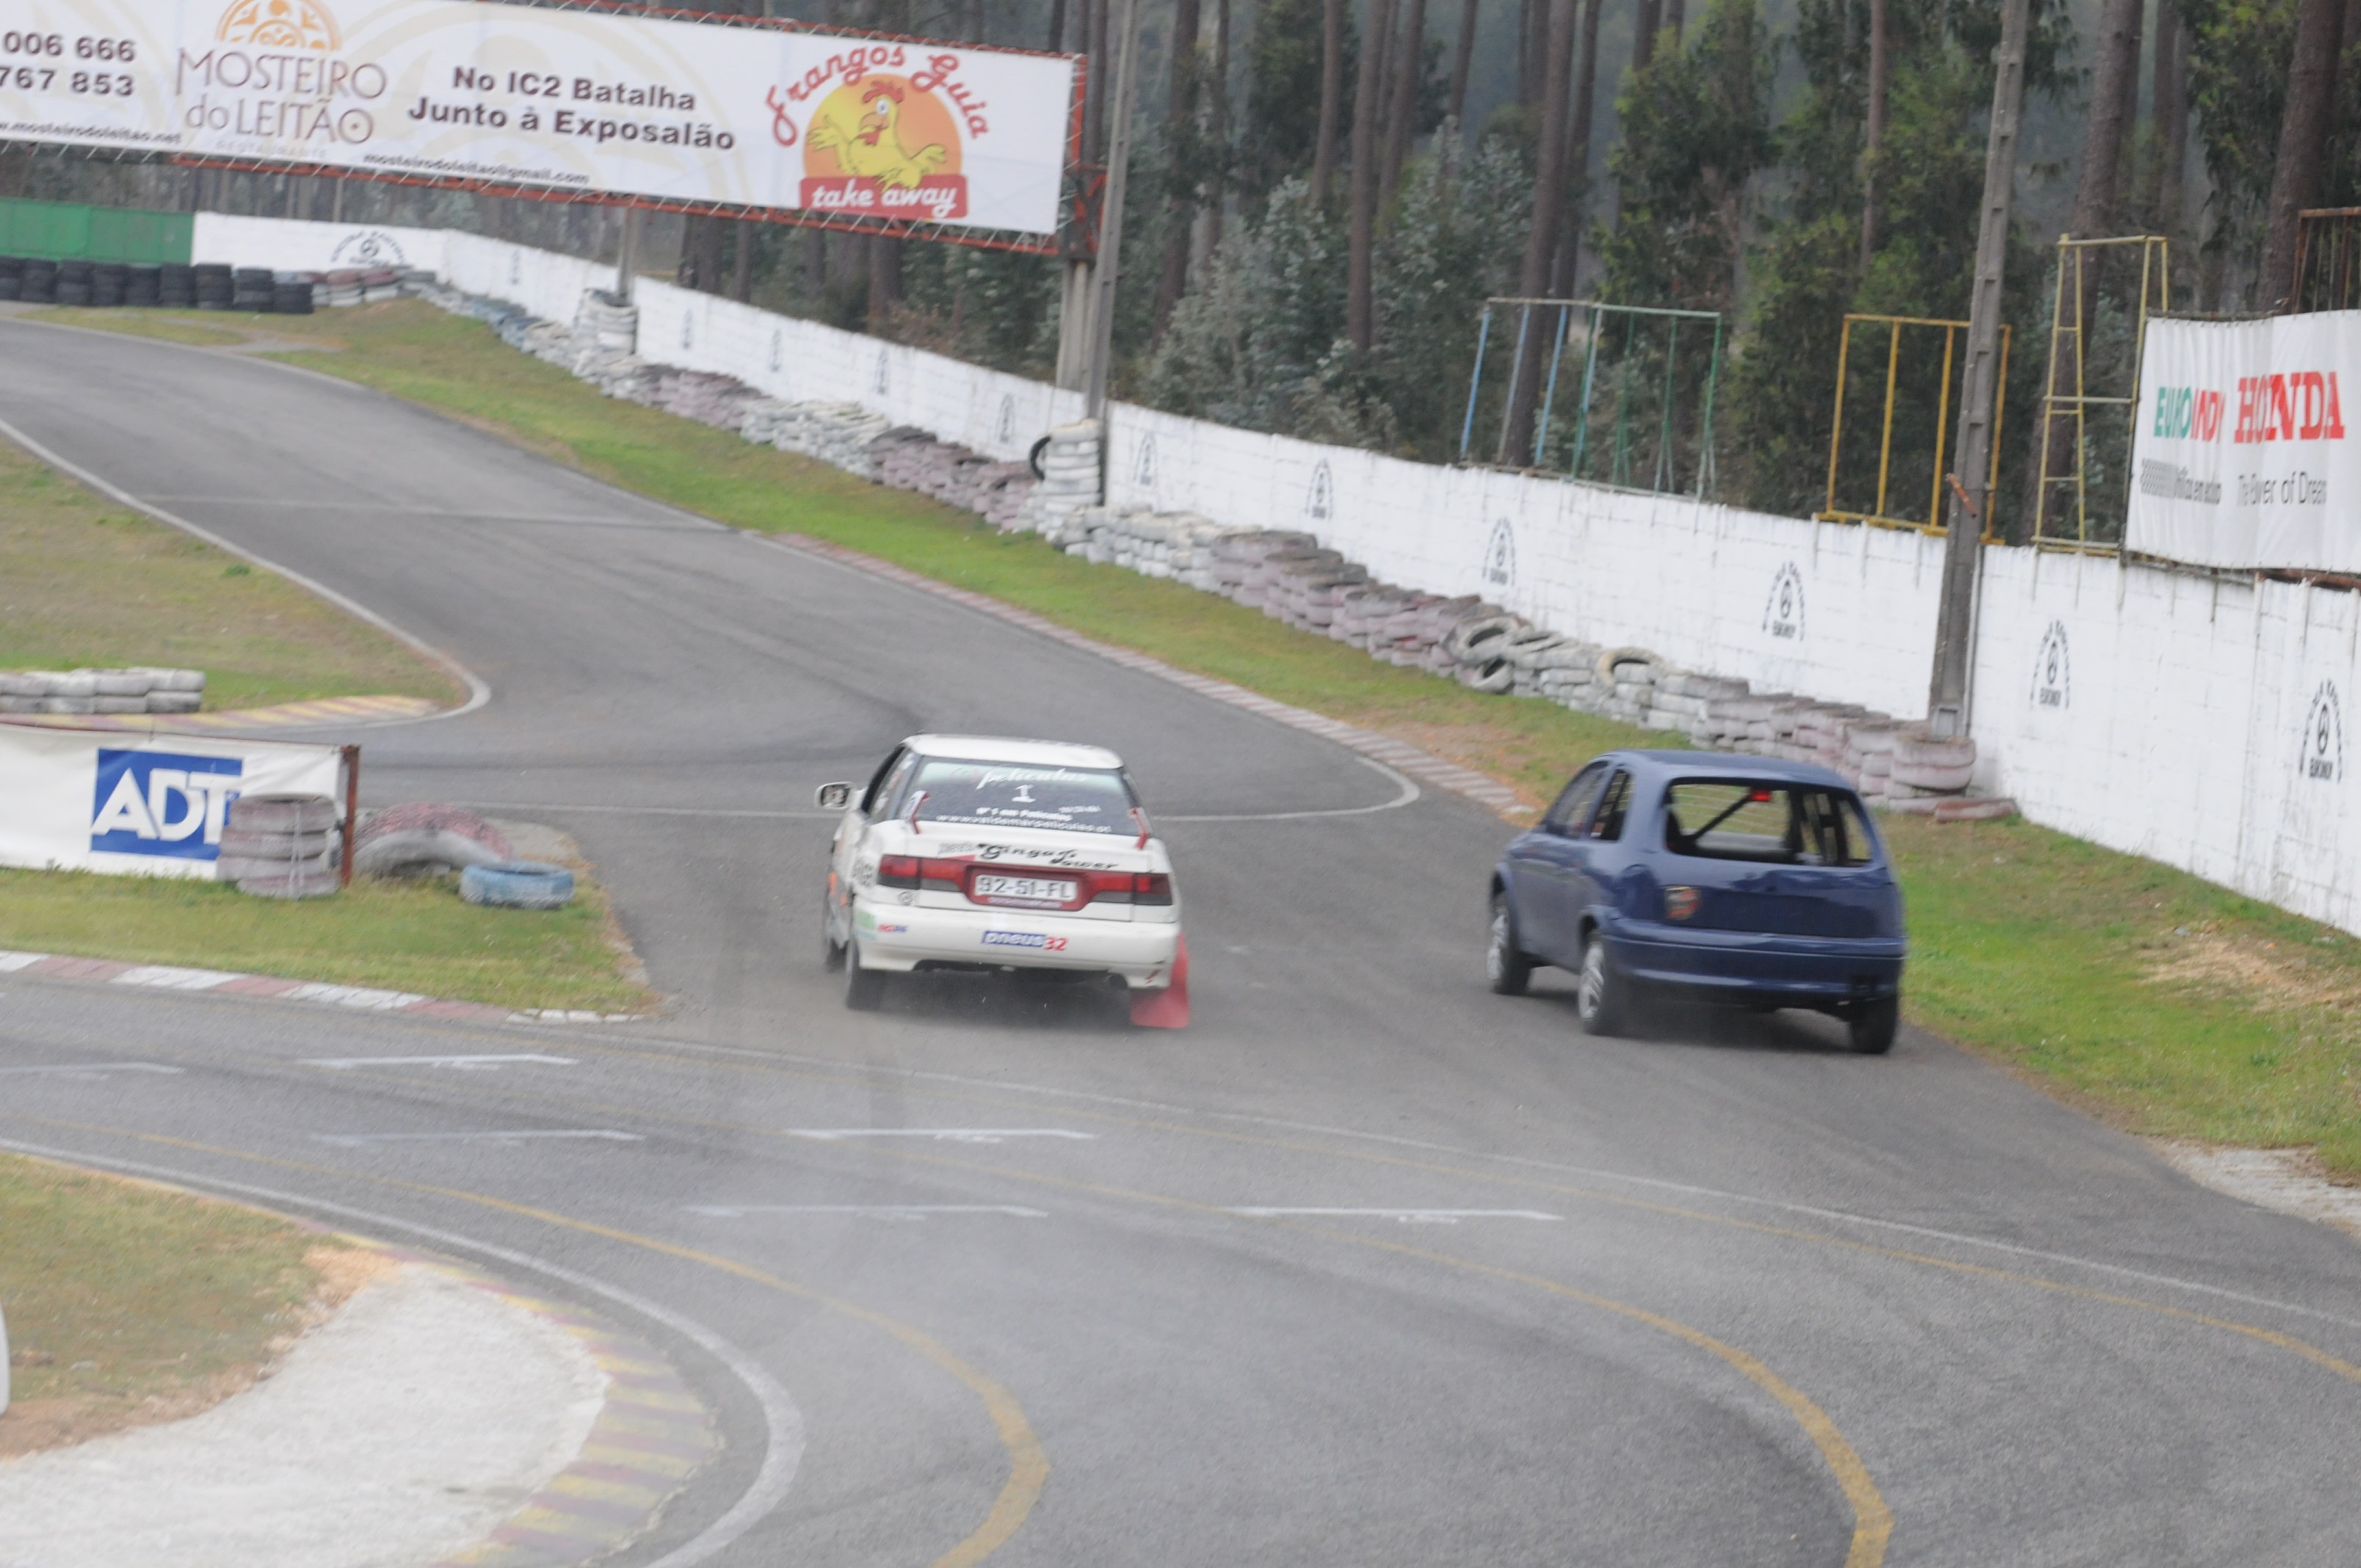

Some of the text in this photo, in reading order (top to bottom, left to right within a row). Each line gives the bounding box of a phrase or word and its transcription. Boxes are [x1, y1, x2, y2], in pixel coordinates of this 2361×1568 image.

[4, 31, 136, 62] 006 666
[72, 71, 134, 96] 853
[175, 47, 388, 99] MOSTEIRO
[451, 65, 696, 112] No IC2 Batalha
[766, 45, 990, 147] Frangos Guia
[408, 96, 735, 150] Junto à Exposalão
[812, 179, 957, 218] take away
[2233, 371, 2346, 445] HONDA
[91, 766, 243, 845] ADT
[1011, 784, 1036, 802] 1
